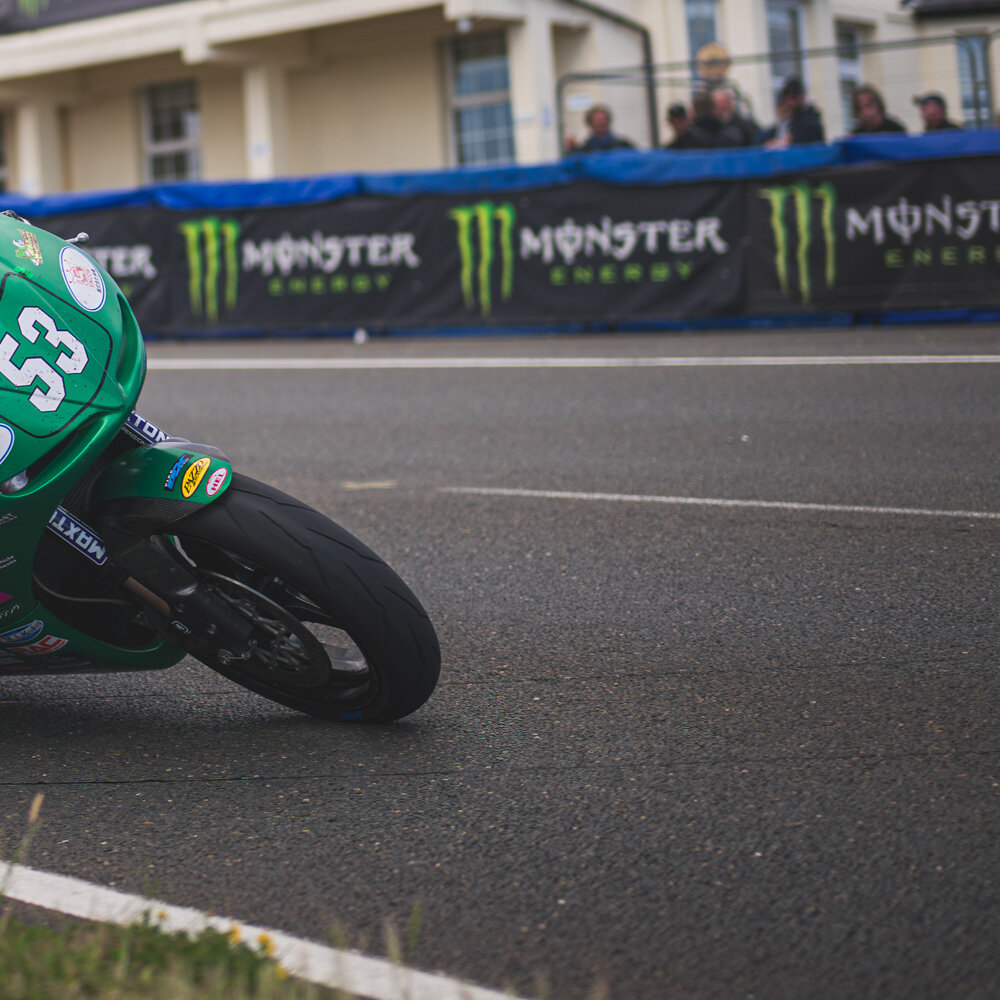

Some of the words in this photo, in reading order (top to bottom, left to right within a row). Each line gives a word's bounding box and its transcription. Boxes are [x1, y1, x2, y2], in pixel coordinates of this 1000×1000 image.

[845, 195, 1000, 243] MONST
[243, 231, 421, 275] MONSTER
[520, 216, 728, 264] MONSTER
[886, 245, 1000, 269] ENER
[550, 260, 695, 286] ENERGY
[127, 412, 171, 442] TON
[211, 473, 225, 492] HEL
[49, 511, 106, 560] MAXT
